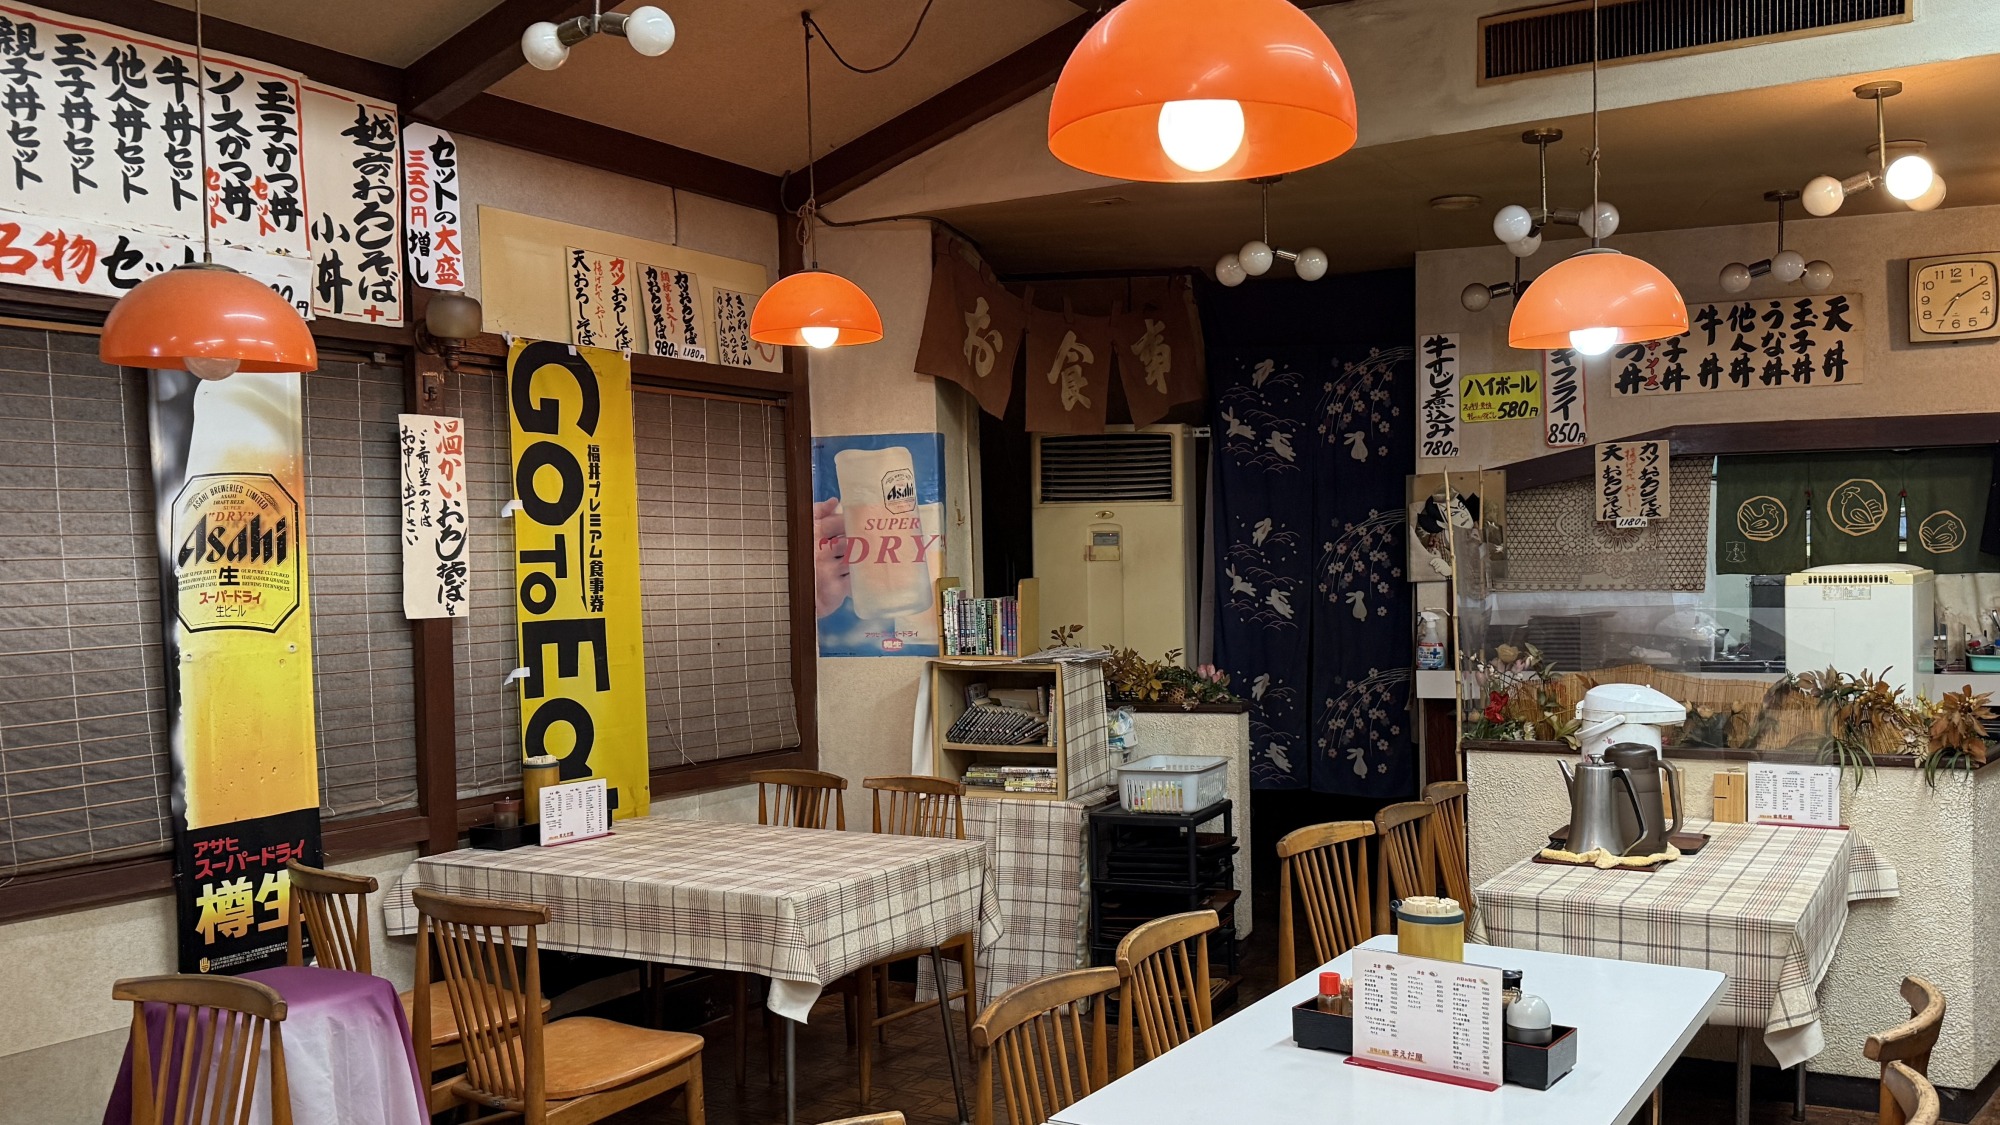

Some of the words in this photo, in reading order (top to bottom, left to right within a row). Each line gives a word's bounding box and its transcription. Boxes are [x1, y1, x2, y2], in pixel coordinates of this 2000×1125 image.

[0, 15, 46, 191] 親子丼セット
[51, 33, 101, 194] 玉子丼セット
[101, 44, 152, 204] 他人丼セット
[152, 55, 201, 211] 牛丼セット
[204, 65, 257, 222] ソースかつ丼
[254, 81, 304, 233] 玉子かつ丼
[428, 134, 464, 287] セットの大盛
[311, 212, 353, 313] 小丼
[1950, 268, 1962, 277] 12
[572, 250, 596, 346] 天おろしそば
[1921, 296, 1930, 305] 9
[1922, 281, 1935, 290] 10
[1982, 291, 1991, 300] 3
[609, 258, 633, 351] カツおろしそば
[1922, 310, 1932, 320] 8
[1980, 306, 1989, 315] 4
[1936, 320, 1945, 329] 7
[1951, 319, 1960, 329] 6
[1968, 317, 1978, 327] 5
[654, 339, 679, 359] 980円
[1693, 304, 1724, 390] 牛丼
[1726, 301, 1757, 388] 他人丼
[1759, 300, 1790, 386] うな丼
[1789, 298, 1819, 385] 玉子丼
[1822, 295, 1853, 383] 天丼
[1423, 334, 1456, 438] 牛すじ煮込み
[1463, 375, 1538, 398] ハイボール
[1498, 400, 1539, 419] 580円
[1423, 440, 1459, 457] 780円
[1547, 422, 1585, 443] 850円
[887, 482, 914, 501] Asahi
[1600, 444, 1624, 520] 天おろしそば
[1638, 442, 1662, 518] カツおろしそば
[587, 444, 605, 613] 福井プレミアム食事券
[864, 517, 920, 531] SUPER
[178, 513, 287, 568] Asahi
[218, 565, 240, 586] 生
[199, 590, 262, 605] スーパードライ
[215, 604, 247, 618] 生ビール
[193, 837, 239, 859] アサヒ
[194, 839, 305, 880] スーパードライ
[1391, 1048, 1423, 1062] まえだ屋
